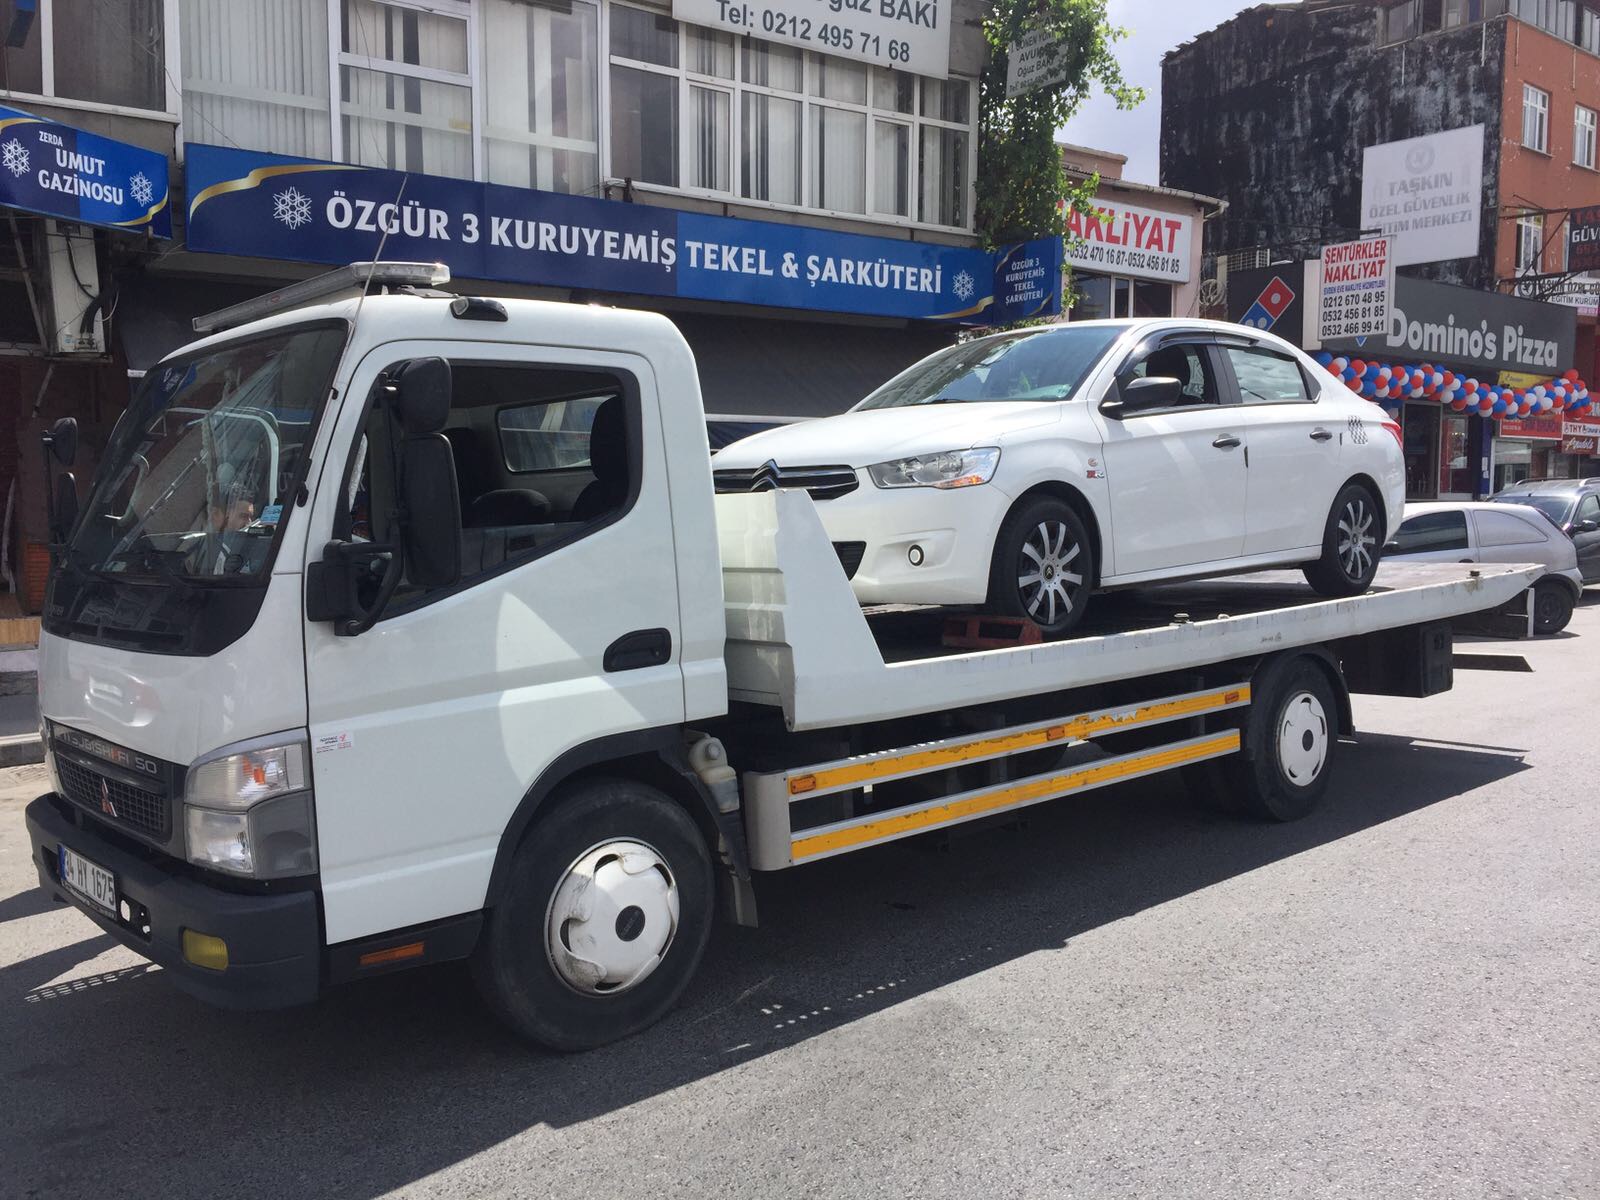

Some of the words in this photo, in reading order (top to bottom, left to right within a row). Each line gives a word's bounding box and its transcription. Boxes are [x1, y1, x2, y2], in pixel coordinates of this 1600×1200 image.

[716, 0, 754, 28] Tel:
[762, 9, 812, 41] 0212
[818, 23, 853, 49] 495
[860, 32, 881, 57] 71
[888, 39, 910, 63] 68
[39, 131, 63, 147] ZERDA
[55, 148, 105, 177] UMUT
[38, 169, 123, 206] GAZİNOSU
[326, 190, 451, 240] ÖZGÜR
[462, 213, 480, 243] 3
[490, 216, 677, 273] KURUYEMİŞ
[685, 240, 773, 276] TEKEL
[781, 252, 799, 279] &
[806, 255, 942, 294] ŞARKÜTERİ
[1572, 225, 1600, 243] GÜV
[1011, 258, 1034, 271] ÖZGÜR
[1035, 257, 1040, 266] 3
[1090, 246, 1104, 262] 470
[1106, 249, 1115, 264] 16
[1147, 255, 1159, 271] 456
[1161, 257, 1168, 272] 81
[1171, 258, 1180, 273] 85
[1014, 281, 1036, 292] TEKEL
[1323, 296, 1343, 308] 0212
[1345, 294, 1360, 306] 670
[1362, 292, 1372, 303] 48
[1375, 291, 1385, 302] 95
[1323, 311, 1342, 322] 0532
[1344, 308, 1359, 320] 456
[1361, 307, 1371, 318] 81
[1374, 305, 1384, 317] 85
[1322, 325, 1342, 336] 0532
[1344, 322, 1359, 334] 466
[1361, 321, 1372, 333] 99
[1374, 320, 1384, 331] 41
[1386, 313, 1497, 360] Domino's
[1502, 325, 1558, 367] Pizza
[135, 757, 157, 774] 50
[77, 858, 87, 893] HY
[92, 867, 114, 906] 1675
